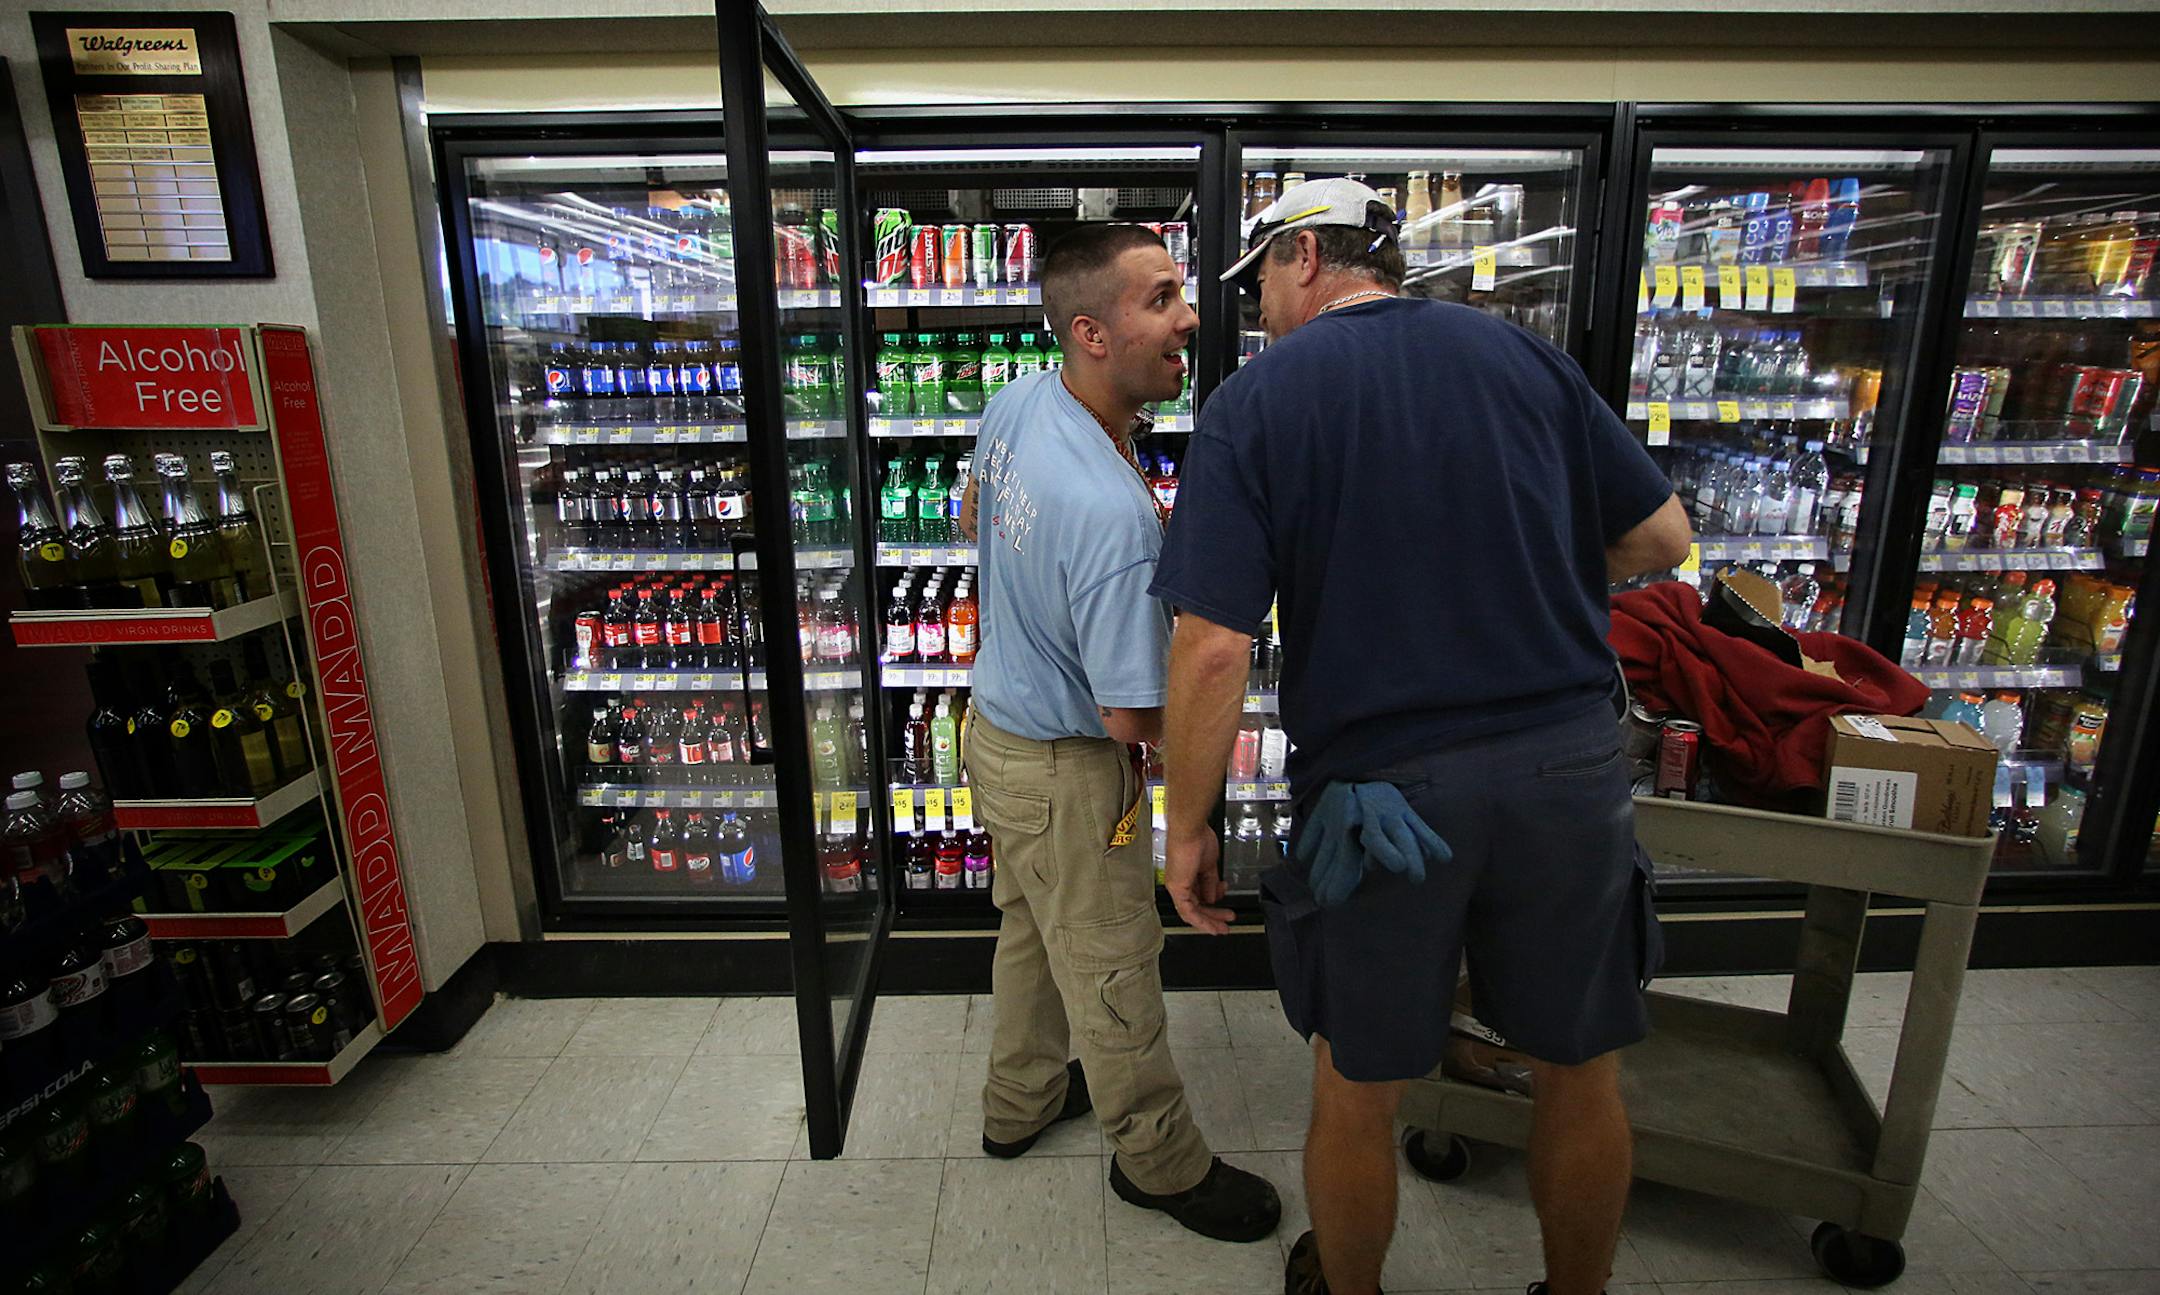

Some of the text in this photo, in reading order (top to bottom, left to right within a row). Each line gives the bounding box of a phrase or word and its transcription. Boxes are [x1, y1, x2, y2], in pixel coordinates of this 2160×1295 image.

[79, 36, 189, 56] Walgreens
[1742, 220, 1760, 261] ZICO
[99, 340, 247, 372] Alcohol
[135, 382, 222, 412] Free
[274, 381, 311, 392] Alcohol
[284, 397, 306, 408] Free
[116, 626, 158, 638] VIRGIN
[162, 625, 208, 636] DRINKS
[303, 546, 376, 776] MADD
[348, 793, 418, 1004] MADD
